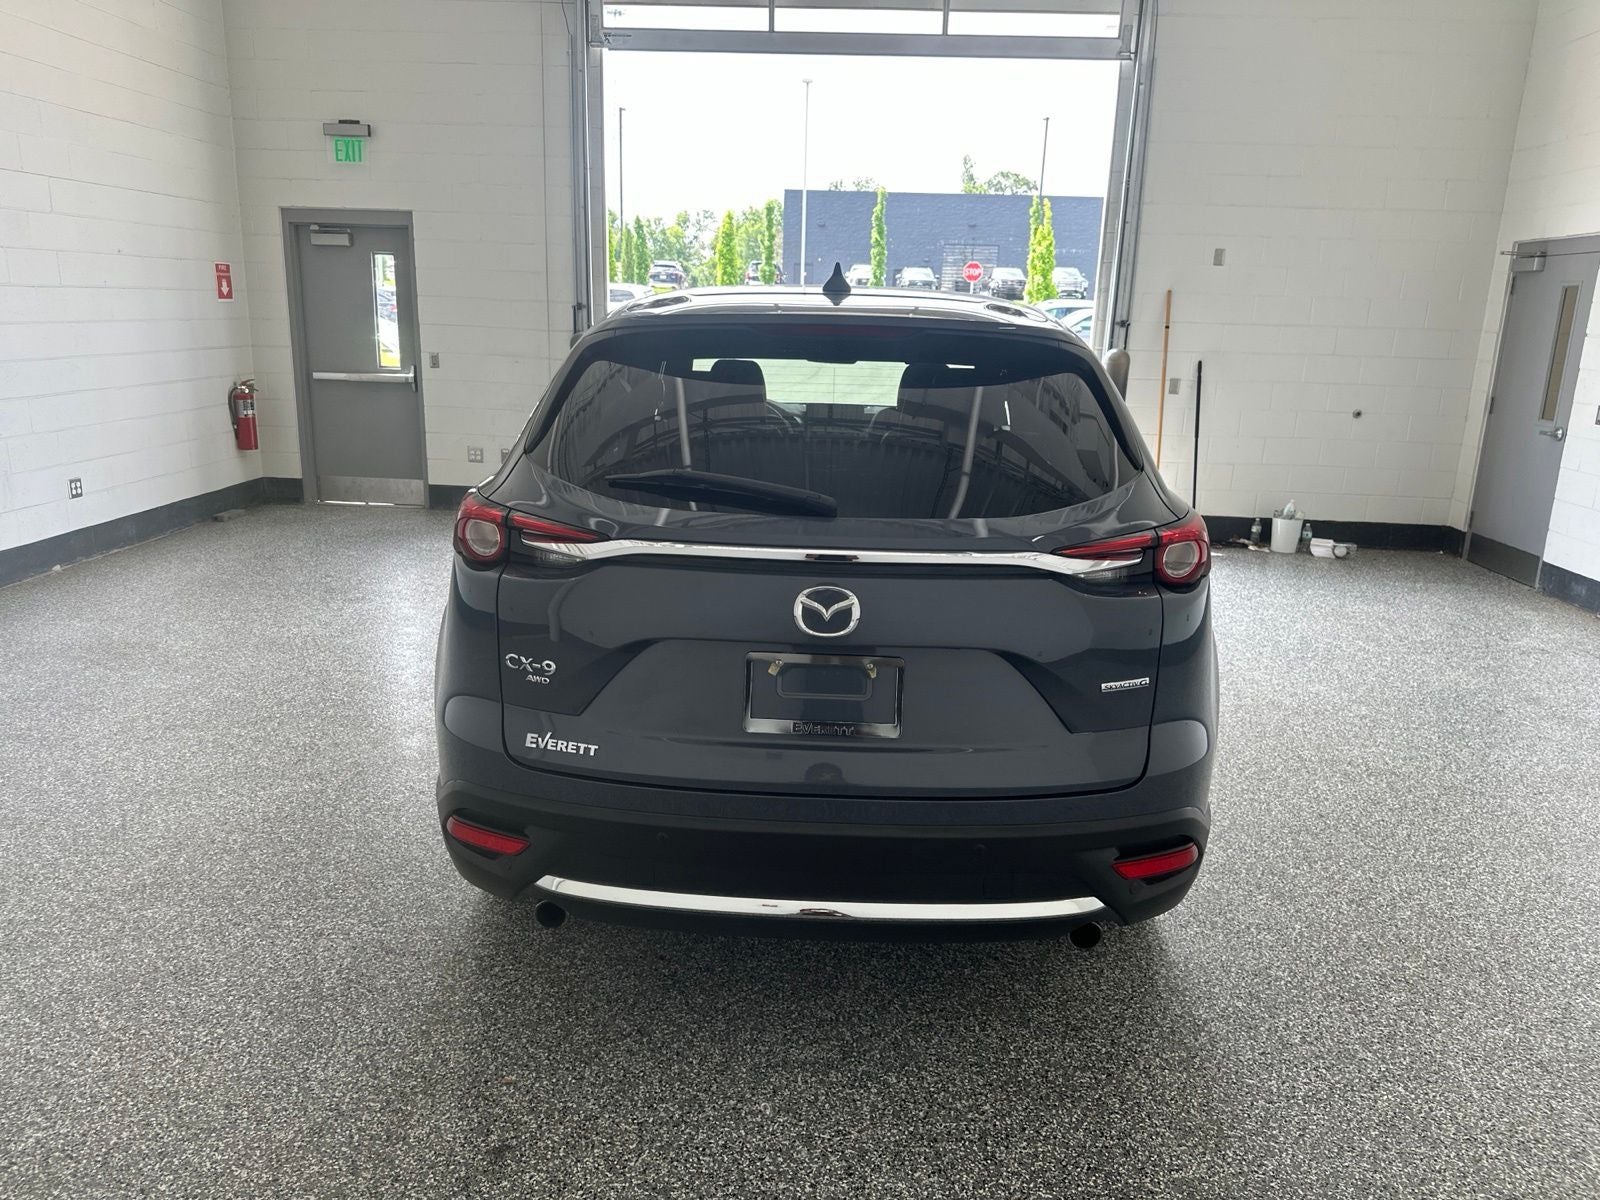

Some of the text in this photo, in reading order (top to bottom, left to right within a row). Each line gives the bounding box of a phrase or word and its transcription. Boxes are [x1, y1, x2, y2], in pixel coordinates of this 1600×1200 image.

[335, 139, 362, 162] EXIT
[964, 267, 981, 276] STOP
[505, 653, 556, 675] CX-9
[526, 674, 550, 684] AWD
[525, 732, 599, 756] EVERETT
